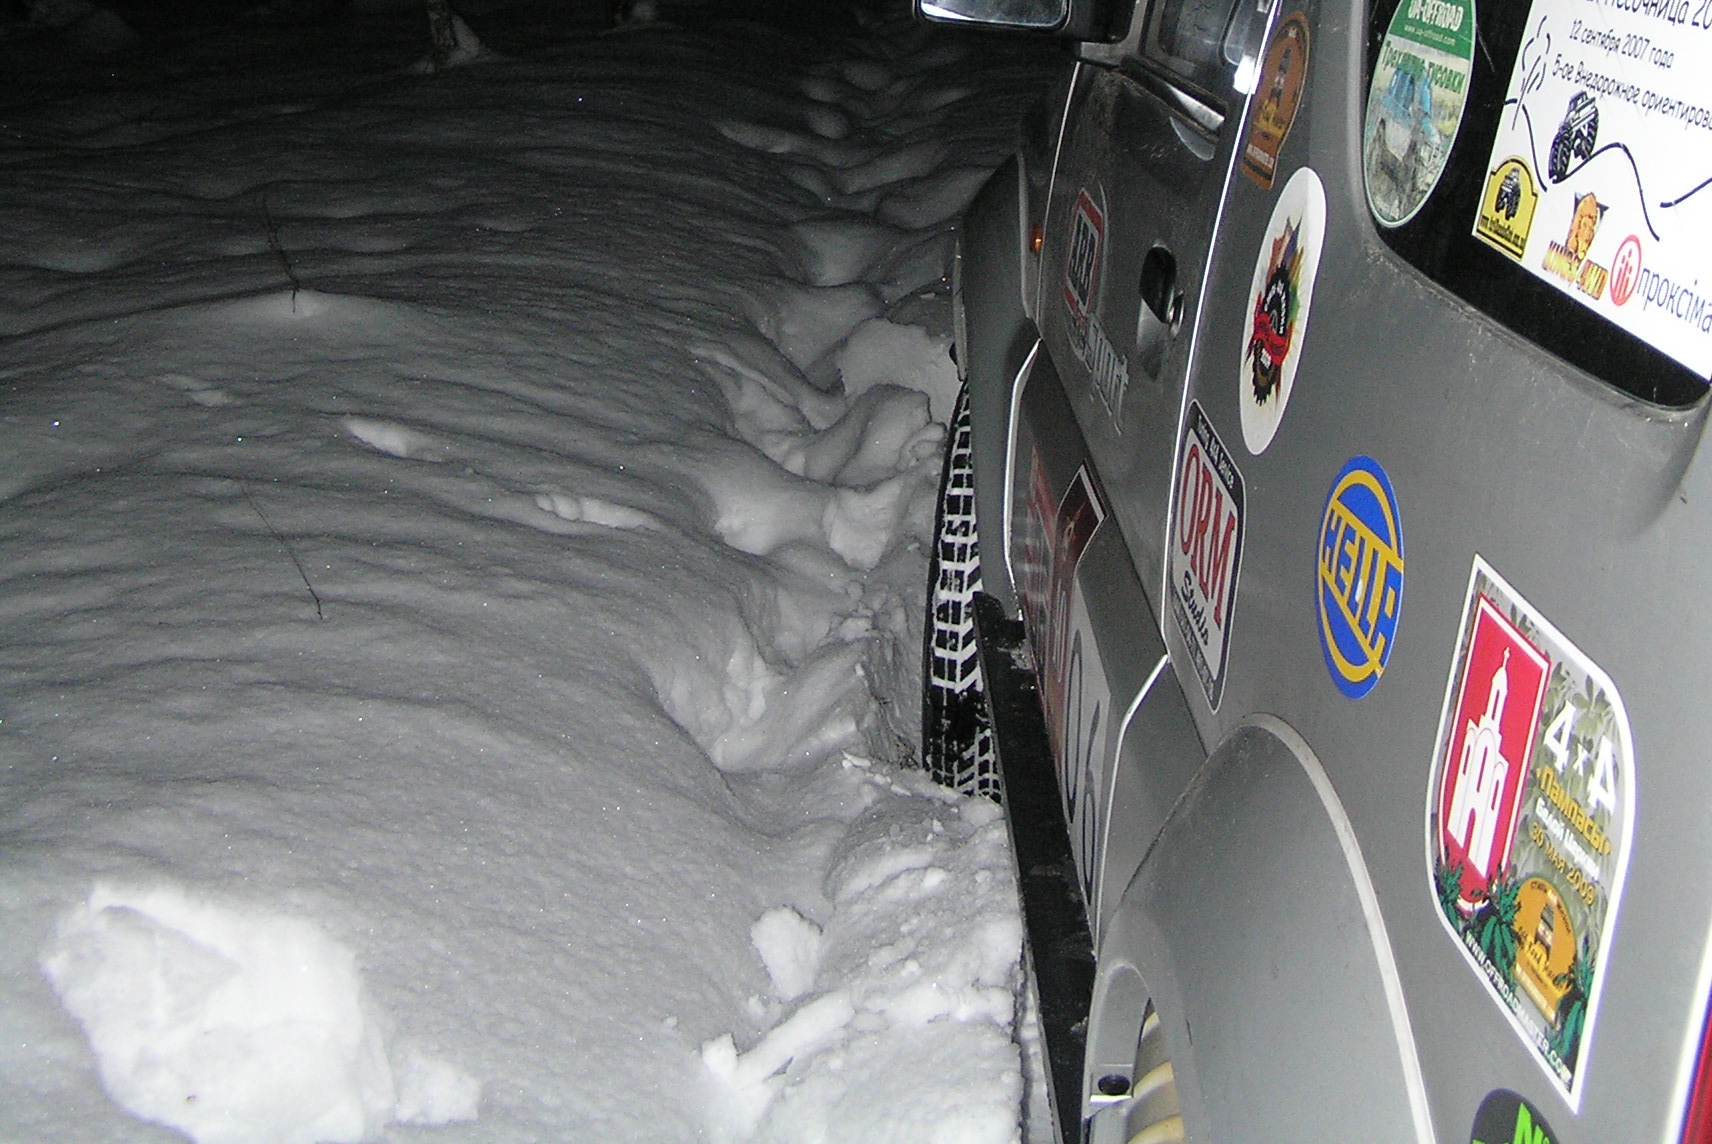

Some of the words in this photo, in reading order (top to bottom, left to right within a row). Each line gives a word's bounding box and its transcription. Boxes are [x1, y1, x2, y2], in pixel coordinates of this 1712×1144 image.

[1569, 18, 1583, 41] 12
[1581, 28, 1622, 58] сентября
[1621, 33, 1651, 59] 2007
[1649, 47, 1675, 69] года
[1180, 444, 1236, 632] ORM
[1323, 506, 1403, 670] HELLA
[1530, 822, 1545, 849] 30
[1566, 866, 1596, 906] 2009
